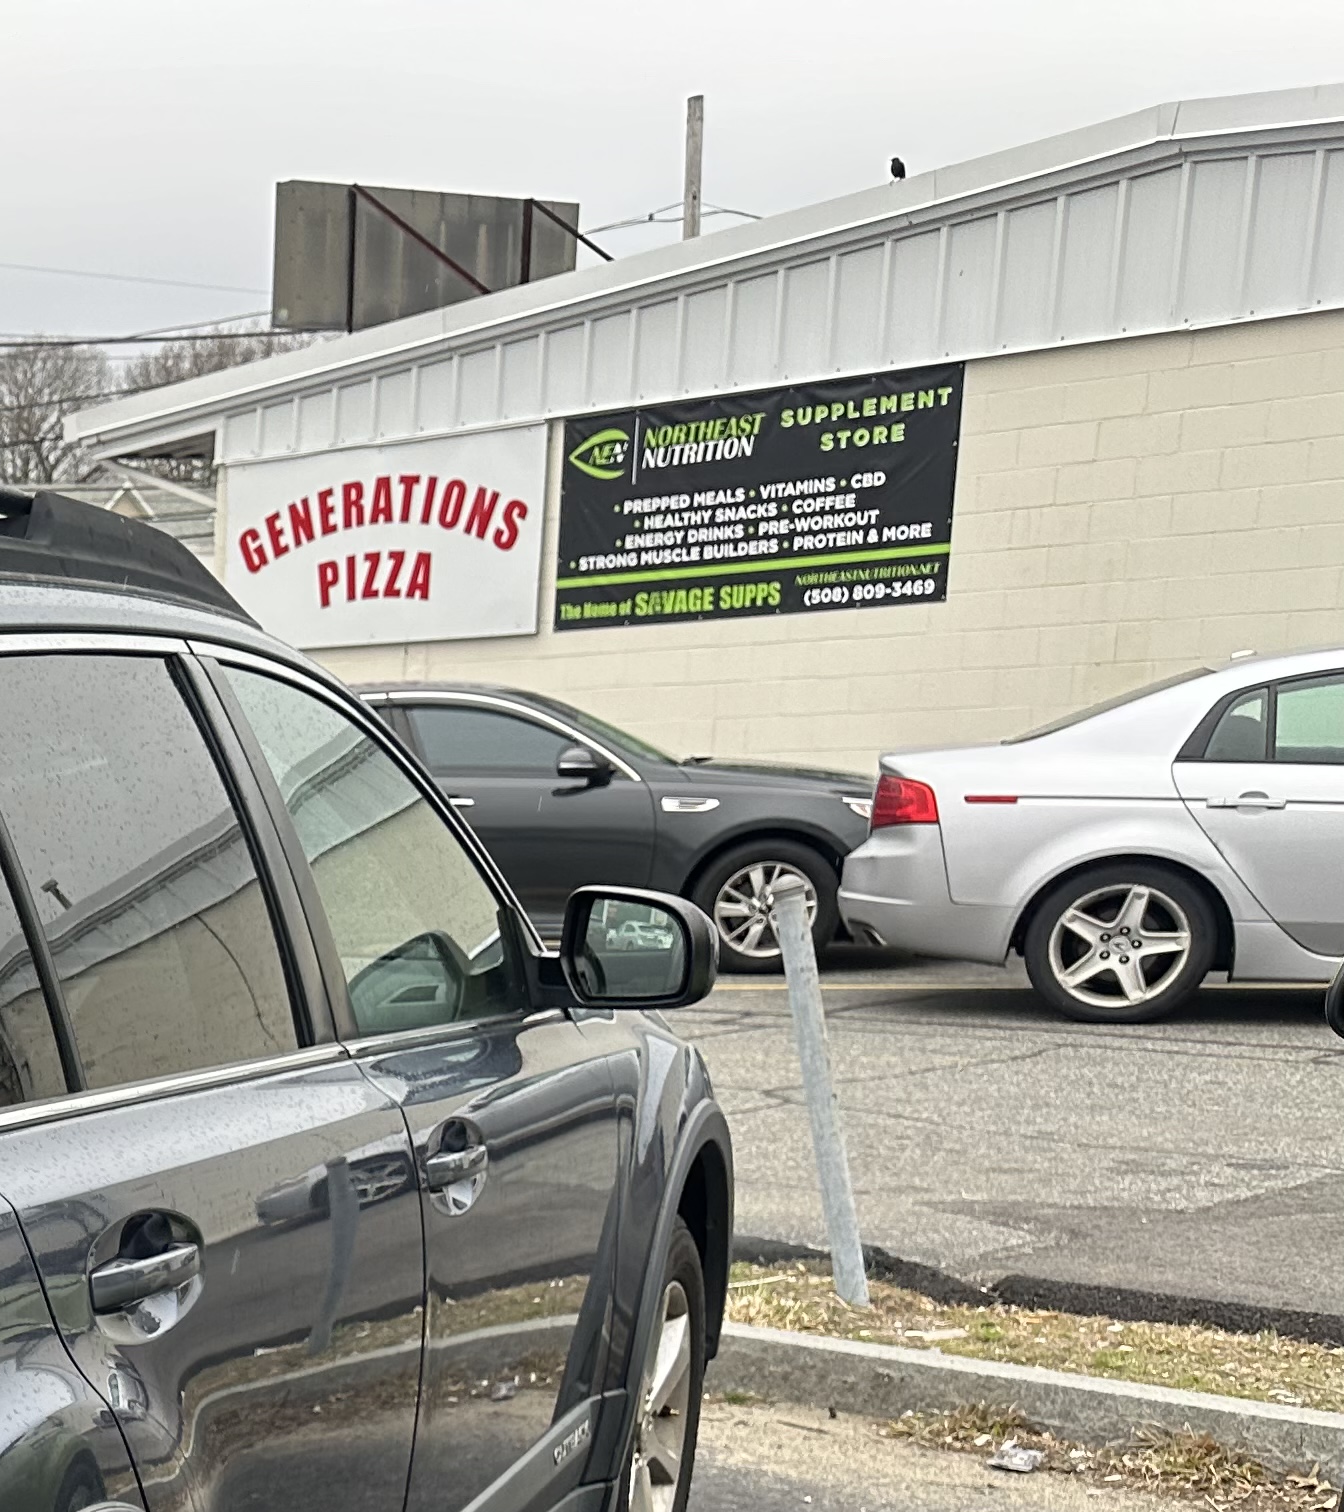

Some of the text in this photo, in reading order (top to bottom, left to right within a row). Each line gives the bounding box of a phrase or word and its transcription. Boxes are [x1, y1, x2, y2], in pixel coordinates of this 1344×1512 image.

[780, 386, 953, 428] SUPPLEMENT
[643, 412, 768, 449] NORTHEAST
[820, 422, 906, 452] STORE
[642, 434, 756, 470] NUTRITION
[622, 471, 887, 515] PREPPED MEALS VITAMINS CBD
[643, 492, 857, 531] HEALTHY SNACKS COFFEE
[238, 474, 529, 575] GENERATIONS
[624, 508, 880, 550] ENERGY DRINKS PRE-WORKOUT
[578, 521, 933, 572] STRONG MUSCLE BUILDERS PROTEIN & MORE
[317, 549, 433, 609] PIZZA
[803, 578, 936, 607] (508) 809-3469
[560, 580, 782, 621] The Home of SAVAGE SUPPS
